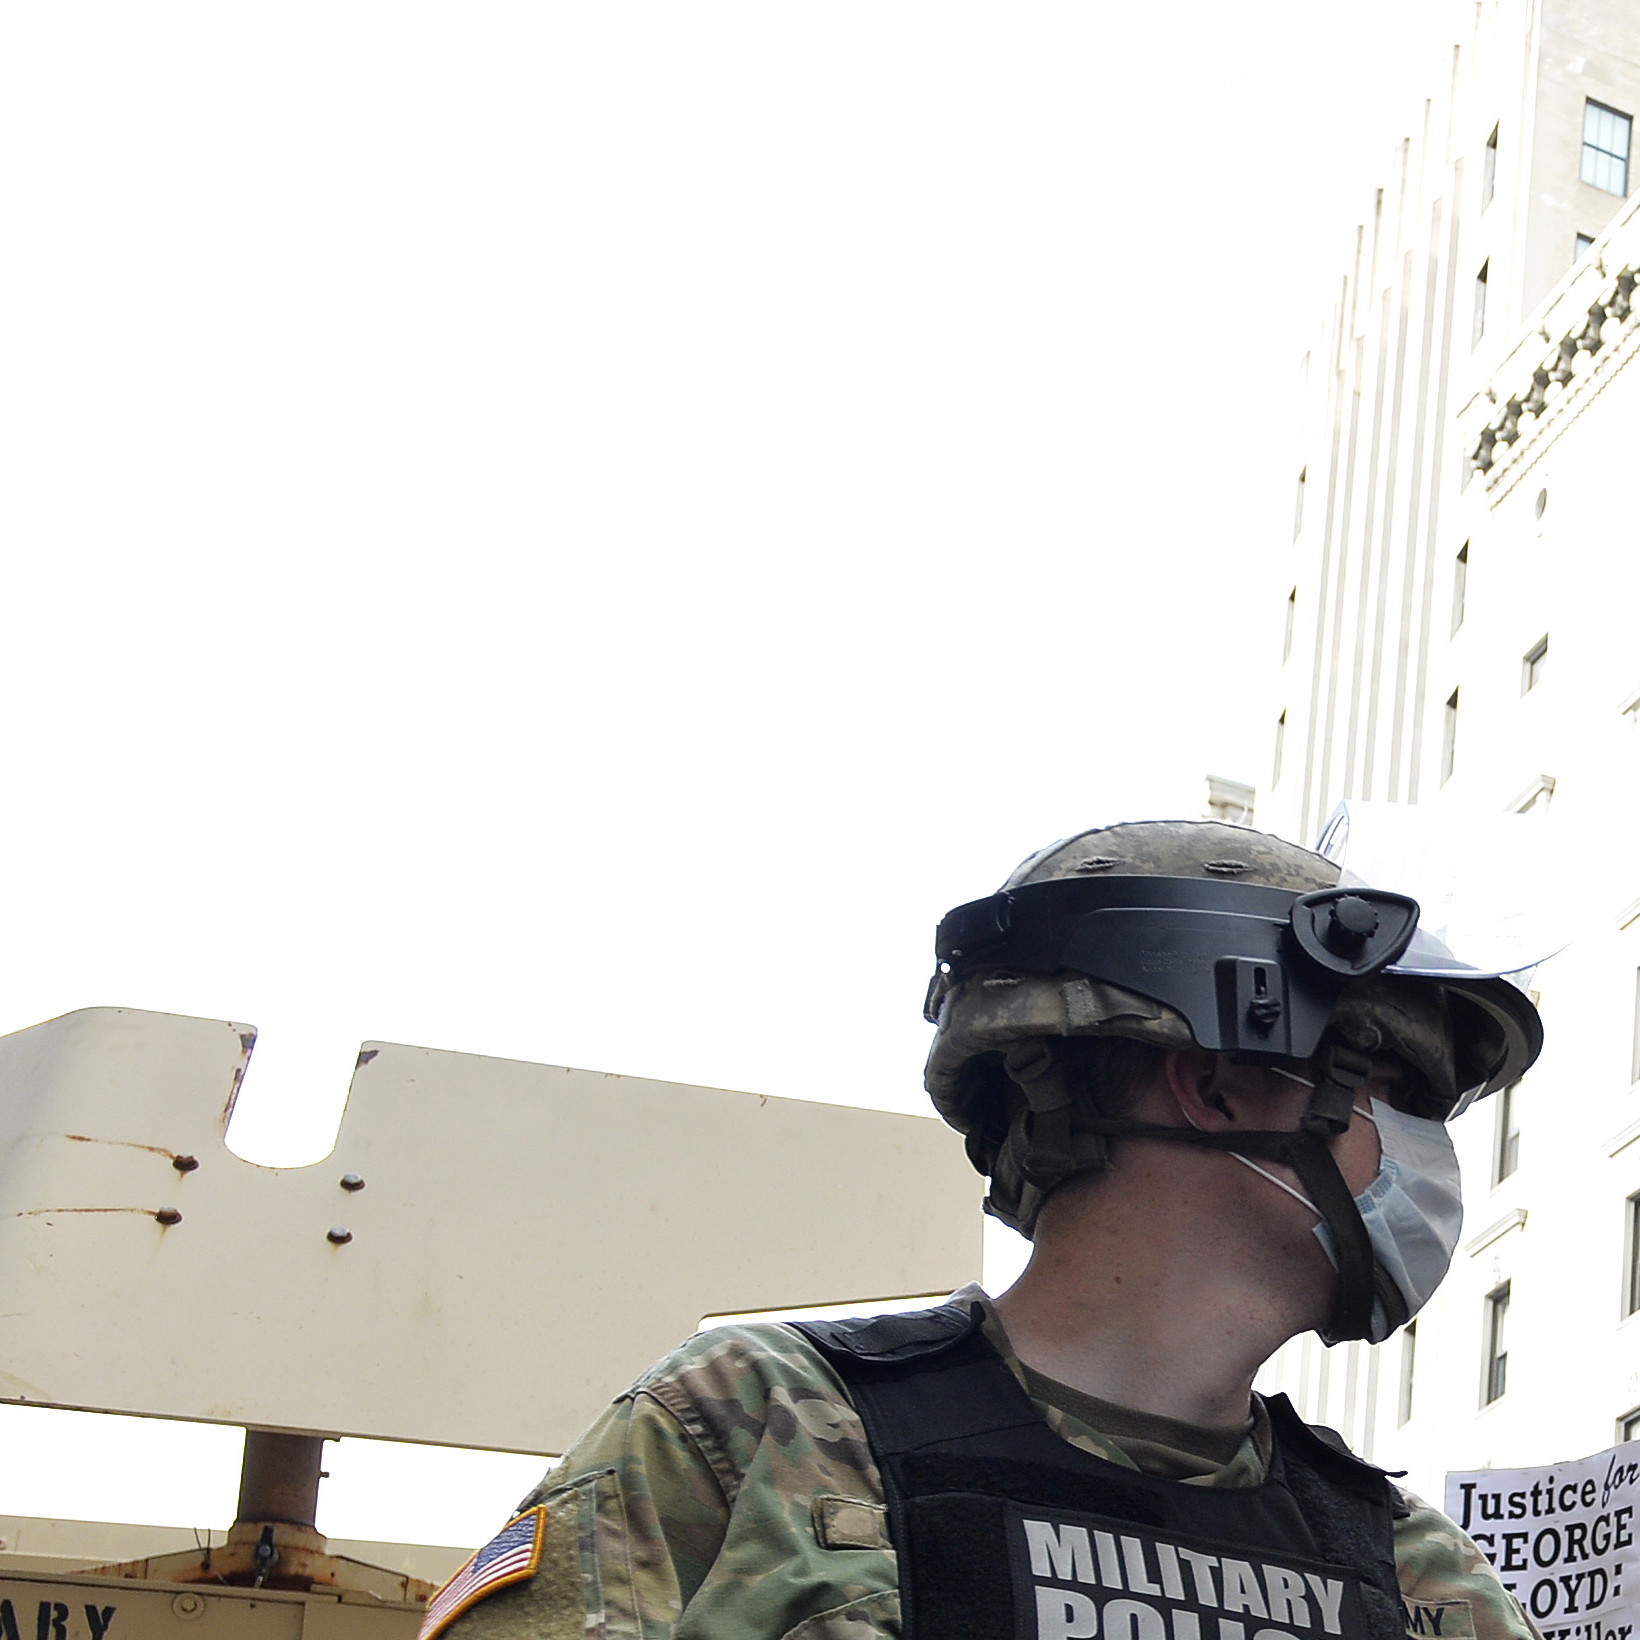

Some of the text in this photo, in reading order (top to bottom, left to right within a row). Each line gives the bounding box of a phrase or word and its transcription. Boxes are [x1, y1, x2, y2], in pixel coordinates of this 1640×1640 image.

[1459, 1453, 1640, 1530] Justice for
[1022, 1518, 1344, 1635] MILITARY
